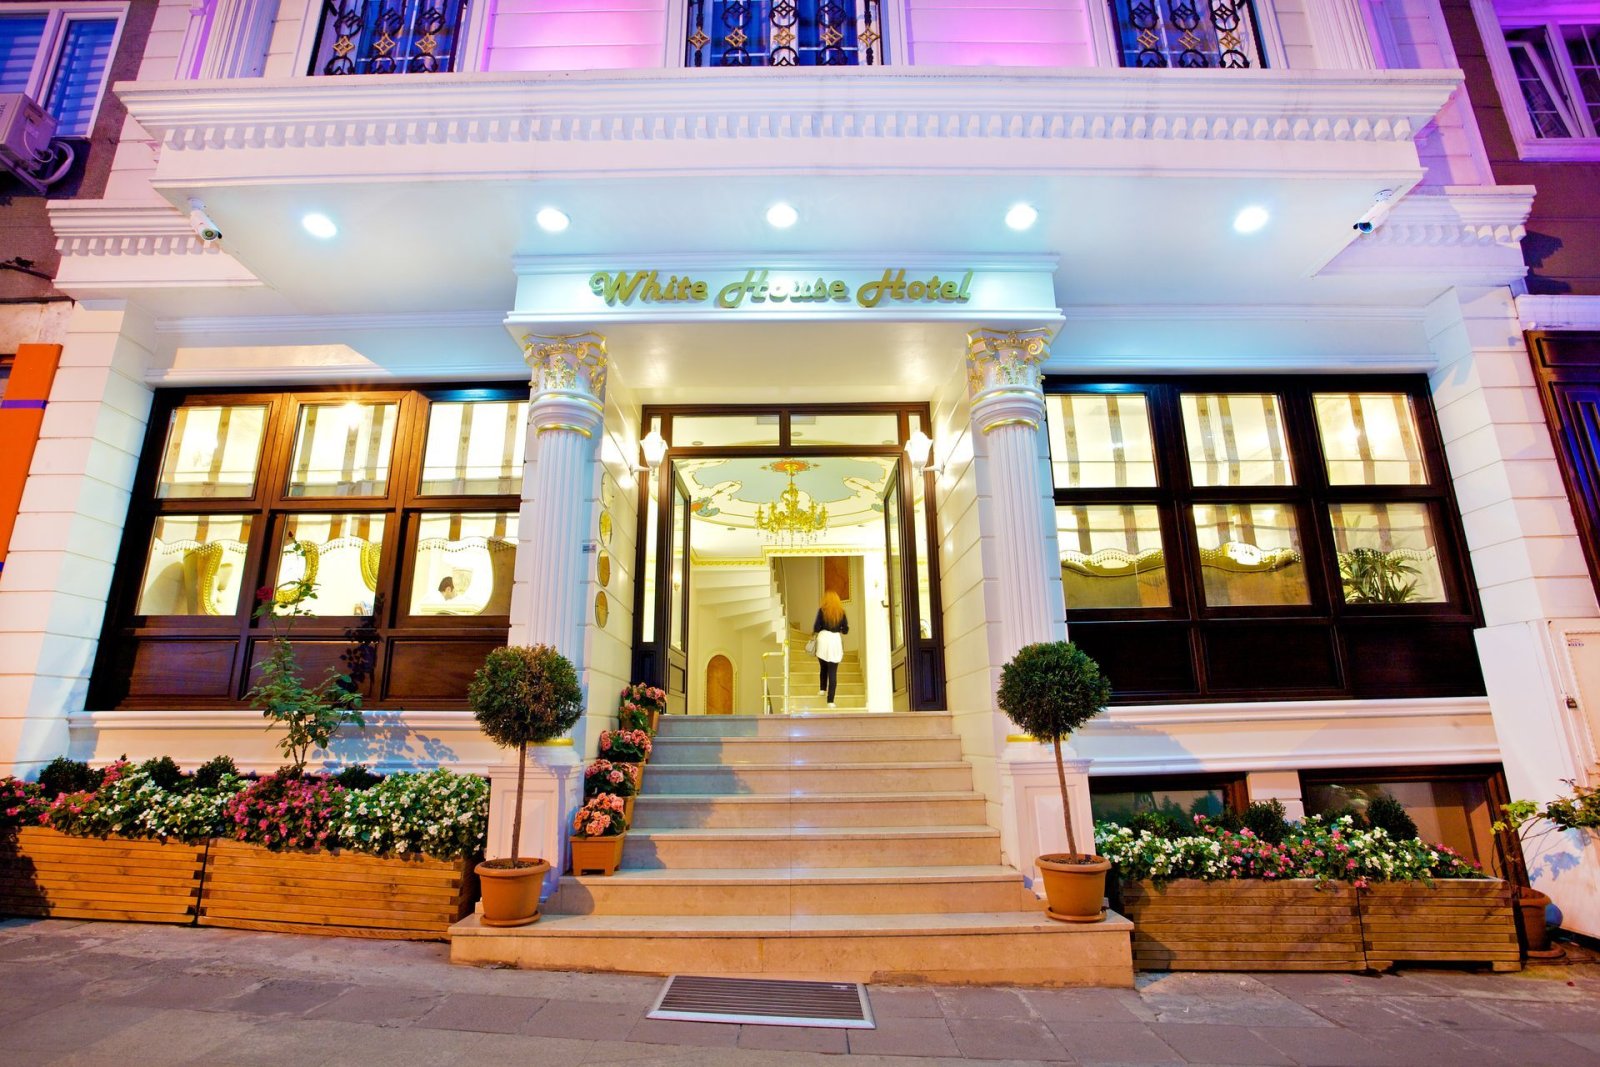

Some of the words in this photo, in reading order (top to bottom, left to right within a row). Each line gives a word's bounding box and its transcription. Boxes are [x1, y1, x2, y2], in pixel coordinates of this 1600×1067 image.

[589, 270, 708, 304] White
[718, 268, 847, 308] House
[856, 268, 973, 308] Hotel
